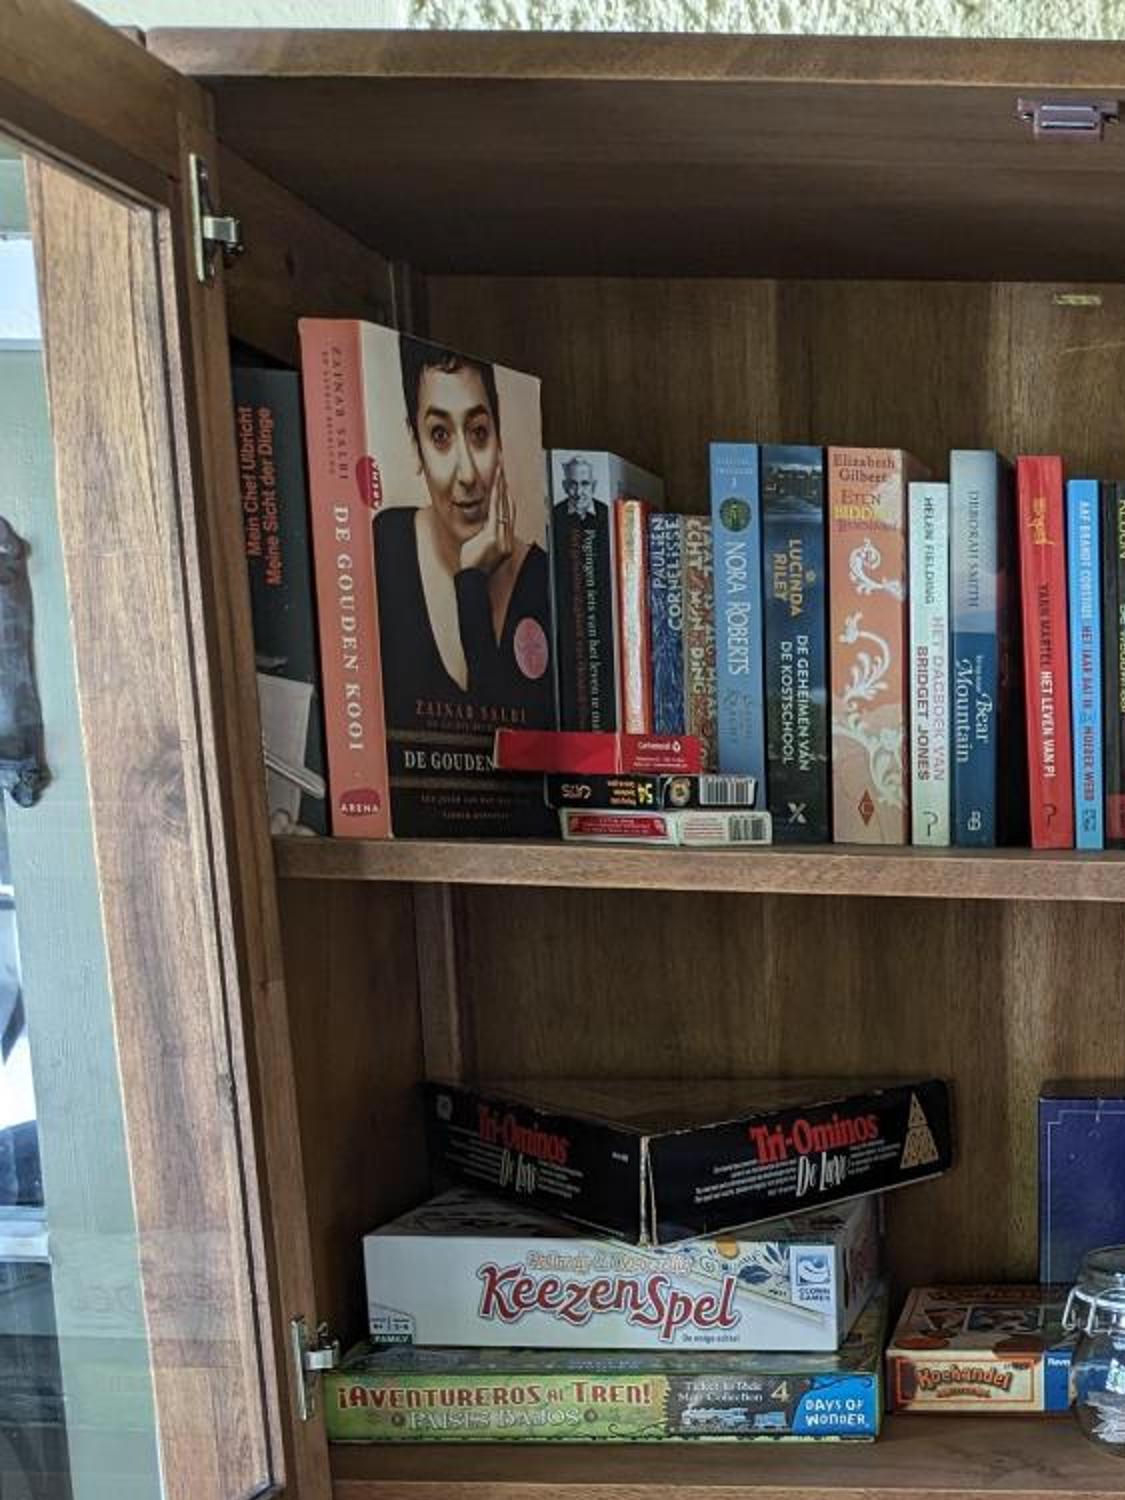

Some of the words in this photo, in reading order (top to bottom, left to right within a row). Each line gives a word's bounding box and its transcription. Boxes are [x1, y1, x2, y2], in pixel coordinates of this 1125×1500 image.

[238, 407, 257, 470] Ulbricht
[242, 473, 259, 513] Chef
[260, 489, 279, 533] Sicht
[333, 503, 350, 542] DE
[923, 496, 936, 541] HELEN
[584, 529, 599, 587] Pogingen
[650, 515, 665, 591] PAULIEN
[686, 519, 703, 572] ECHT
[724, 541, 748, 594] NORA
[665, 514, 683, 632] CORNELISSE
[772, 553, 789, 602] RILEY
[788, 539, 804, 618] LUCINDA
[924, 545, 937, 606] FIELDING
[335, 550, 357, 670] GOUDEN
[586, 589, 598, 612] iets
[725, 600, 753, 676] ROBERTS
[780, 640, 794, 660] DE
[796, 635, 810, 655] DE
[930, 617, 945, 649] HET
[1081, 625, 1093, 647] HET
[796, 659, 811, 738] GEHEIMEN
[915, 645, 930, 719] BRIDGET
[931, 655, 945, 738] DAGBOEK
[1040, 671, 1053, 693] HET
[343, 681, 364, 751] KOOI
[781, 664, 796, 766] KOSTSCHOOL
[955, 658, 975, 764] Mountain
[973, 692, 994, 744] Bear
[1040, 697, 1054, 733] LEVEN
[403, 750, 427, 769] DE
[798, 741, 812, 772] VAN
[917, 725, 931, 782] JONES
[933, 743, 946, 782] VAN
[1042, 738, 1055, 763] VAN
[340, 801, 382, 813] ARENA
[480, 1107, 571, 1162] Tri-Ominos
[752, 1118, 881, 1167] Tri-Ominos
[796, 1156, 818, 1198] De
[573, 1381, 652, 1406] TREN!
[770, 1380, 791, 1402] 4
[805, 1399, 839, 1412] DAYS
[844, 1398, 863, 1412] OF
[805, 1414, 866, 1427] WONDER
